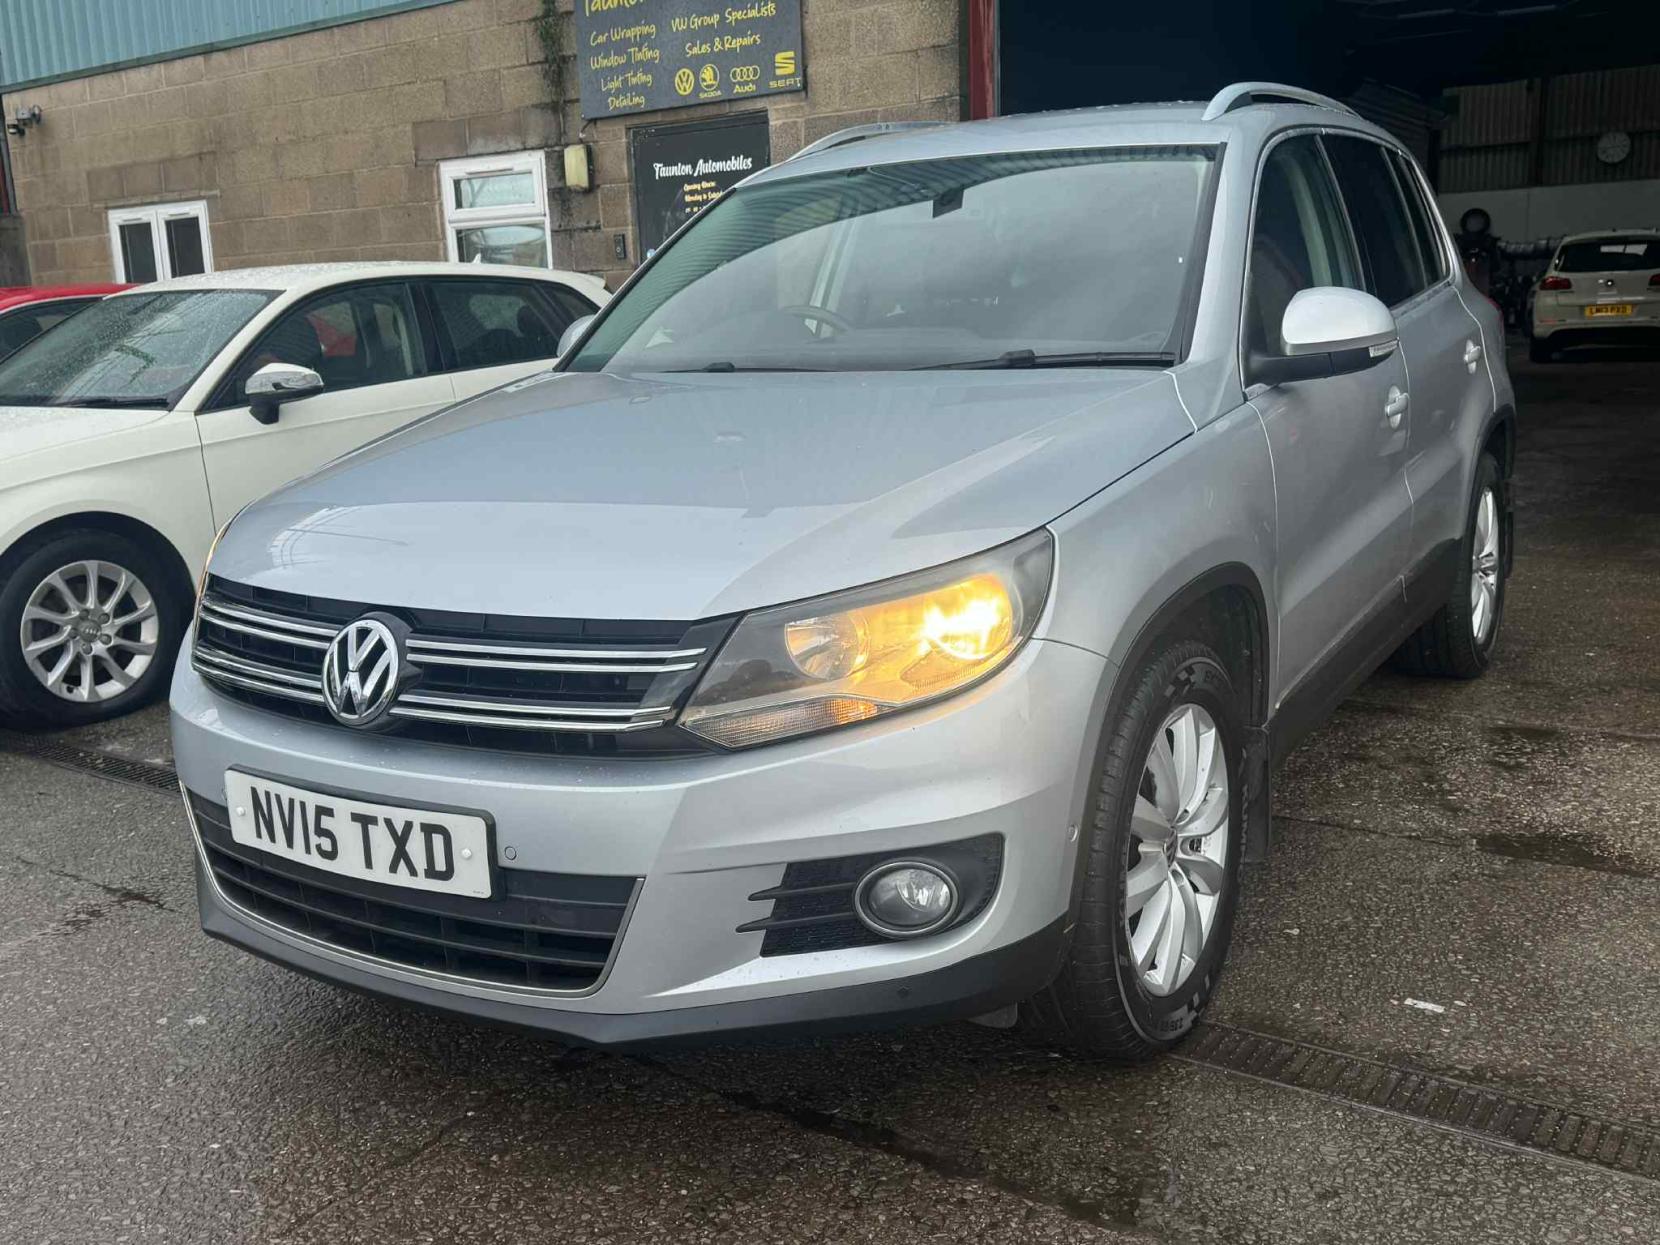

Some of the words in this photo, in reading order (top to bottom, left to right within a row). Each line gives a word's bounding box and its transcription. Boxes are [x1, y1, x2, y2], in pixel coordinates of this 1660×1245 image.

[671, 16, 688, 32] VW
[689, 13, 720, 29] Group
[725, 1, 777, 27] Specialists
[590, 31, 608, 46] Car
[610, 20, 656, 42] Wrapping
[685, 40, 711, 57] Sales
[713, 37, 724, 52] &
[724, 30, 761, 53] Repairs
[590, 50, 627, 70] Window
[627, 43, 660, 64] Tinting
[601, 74, 624, 93] Light
[624, 68, 652, 87] Tinting
[733, 82, 756, 94] Audi
[768, 77, 801, 89] SEAT
[608, 91, 646, 112] Detailing
[653, 162, 693, 180] Taunton
[693, 154, 753, 177] Automobiles
[251, 786, 338, 861] NV15
[350, 811, 455, 882] TXD
